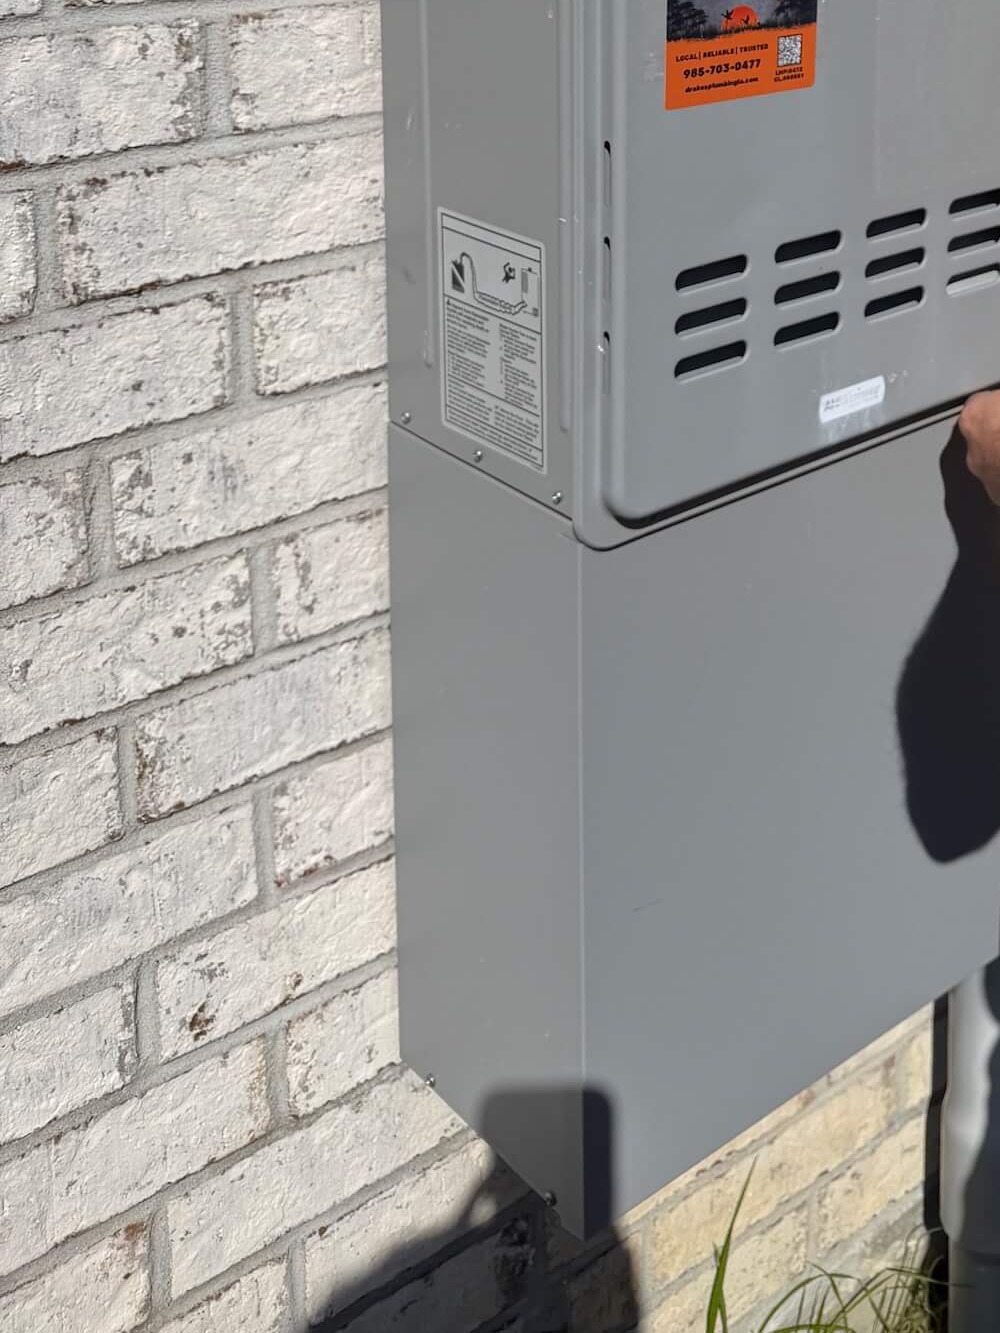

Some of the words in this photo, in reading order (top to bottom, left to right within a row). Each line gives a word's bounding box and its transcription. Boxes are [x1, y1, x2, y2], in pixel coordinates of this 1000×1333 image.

[675, 53, 698, 62] LOCAL
[703, 47, 734, 59] RELIABLE
[739, 43, 769, 53] TRUSTED
[683, 59, 761, 78] 985-703-0477
